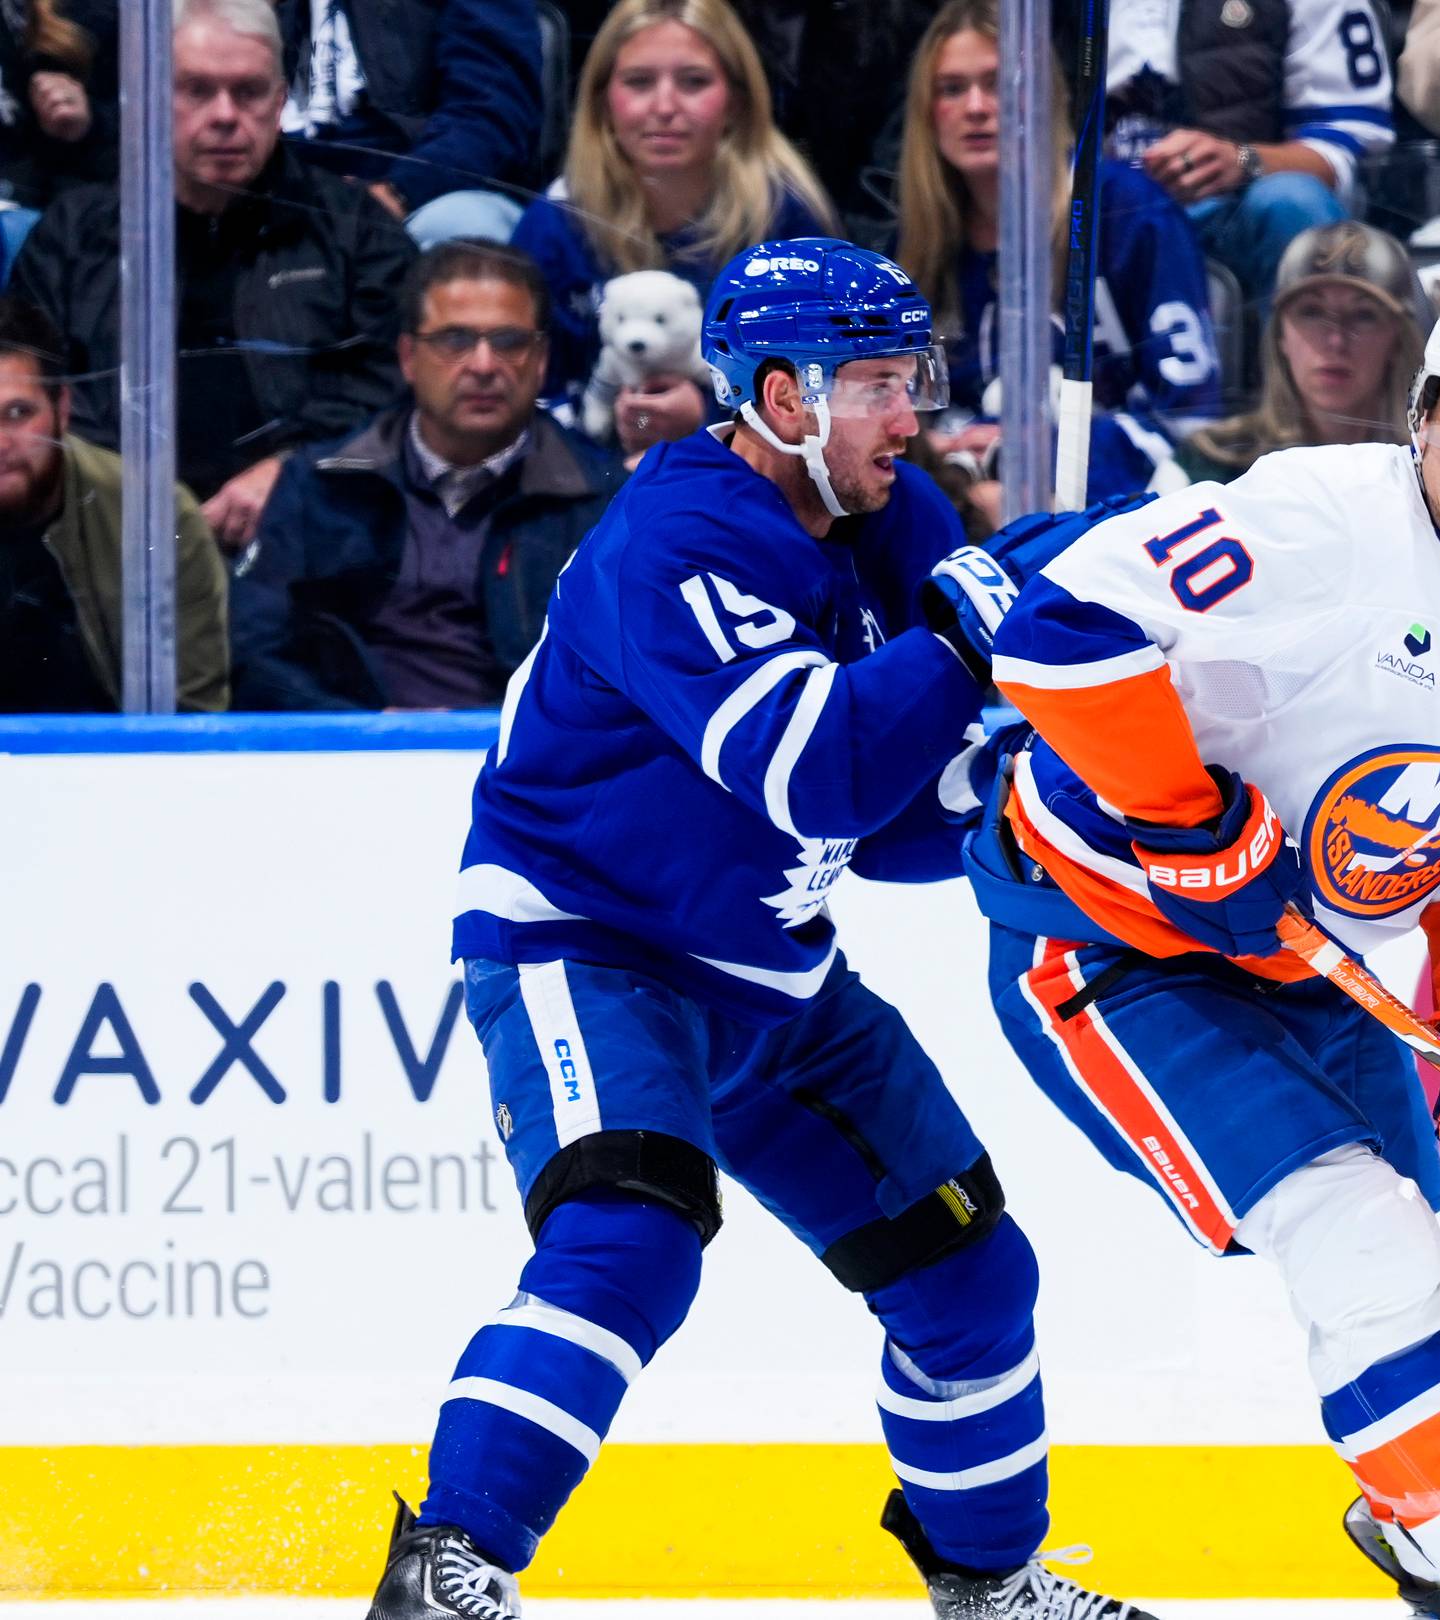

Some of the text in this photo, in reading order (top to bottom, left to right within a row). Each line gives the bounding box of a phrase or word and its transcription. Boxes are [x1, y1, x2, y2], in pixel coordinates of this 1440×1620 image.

[1338, 11, 1382, 89] 8
[744, 257, 820, 277] OREO
[901, 310, 929, 324] CCM
[1142, 507, 1254, 613] 10
[680, 571, 797, 664] 15
[1376, 650, 1436, 686] VANDA
[553, 1038, 581, 1102] CCM
[160, 1131, 499, 1215] 21-valent
